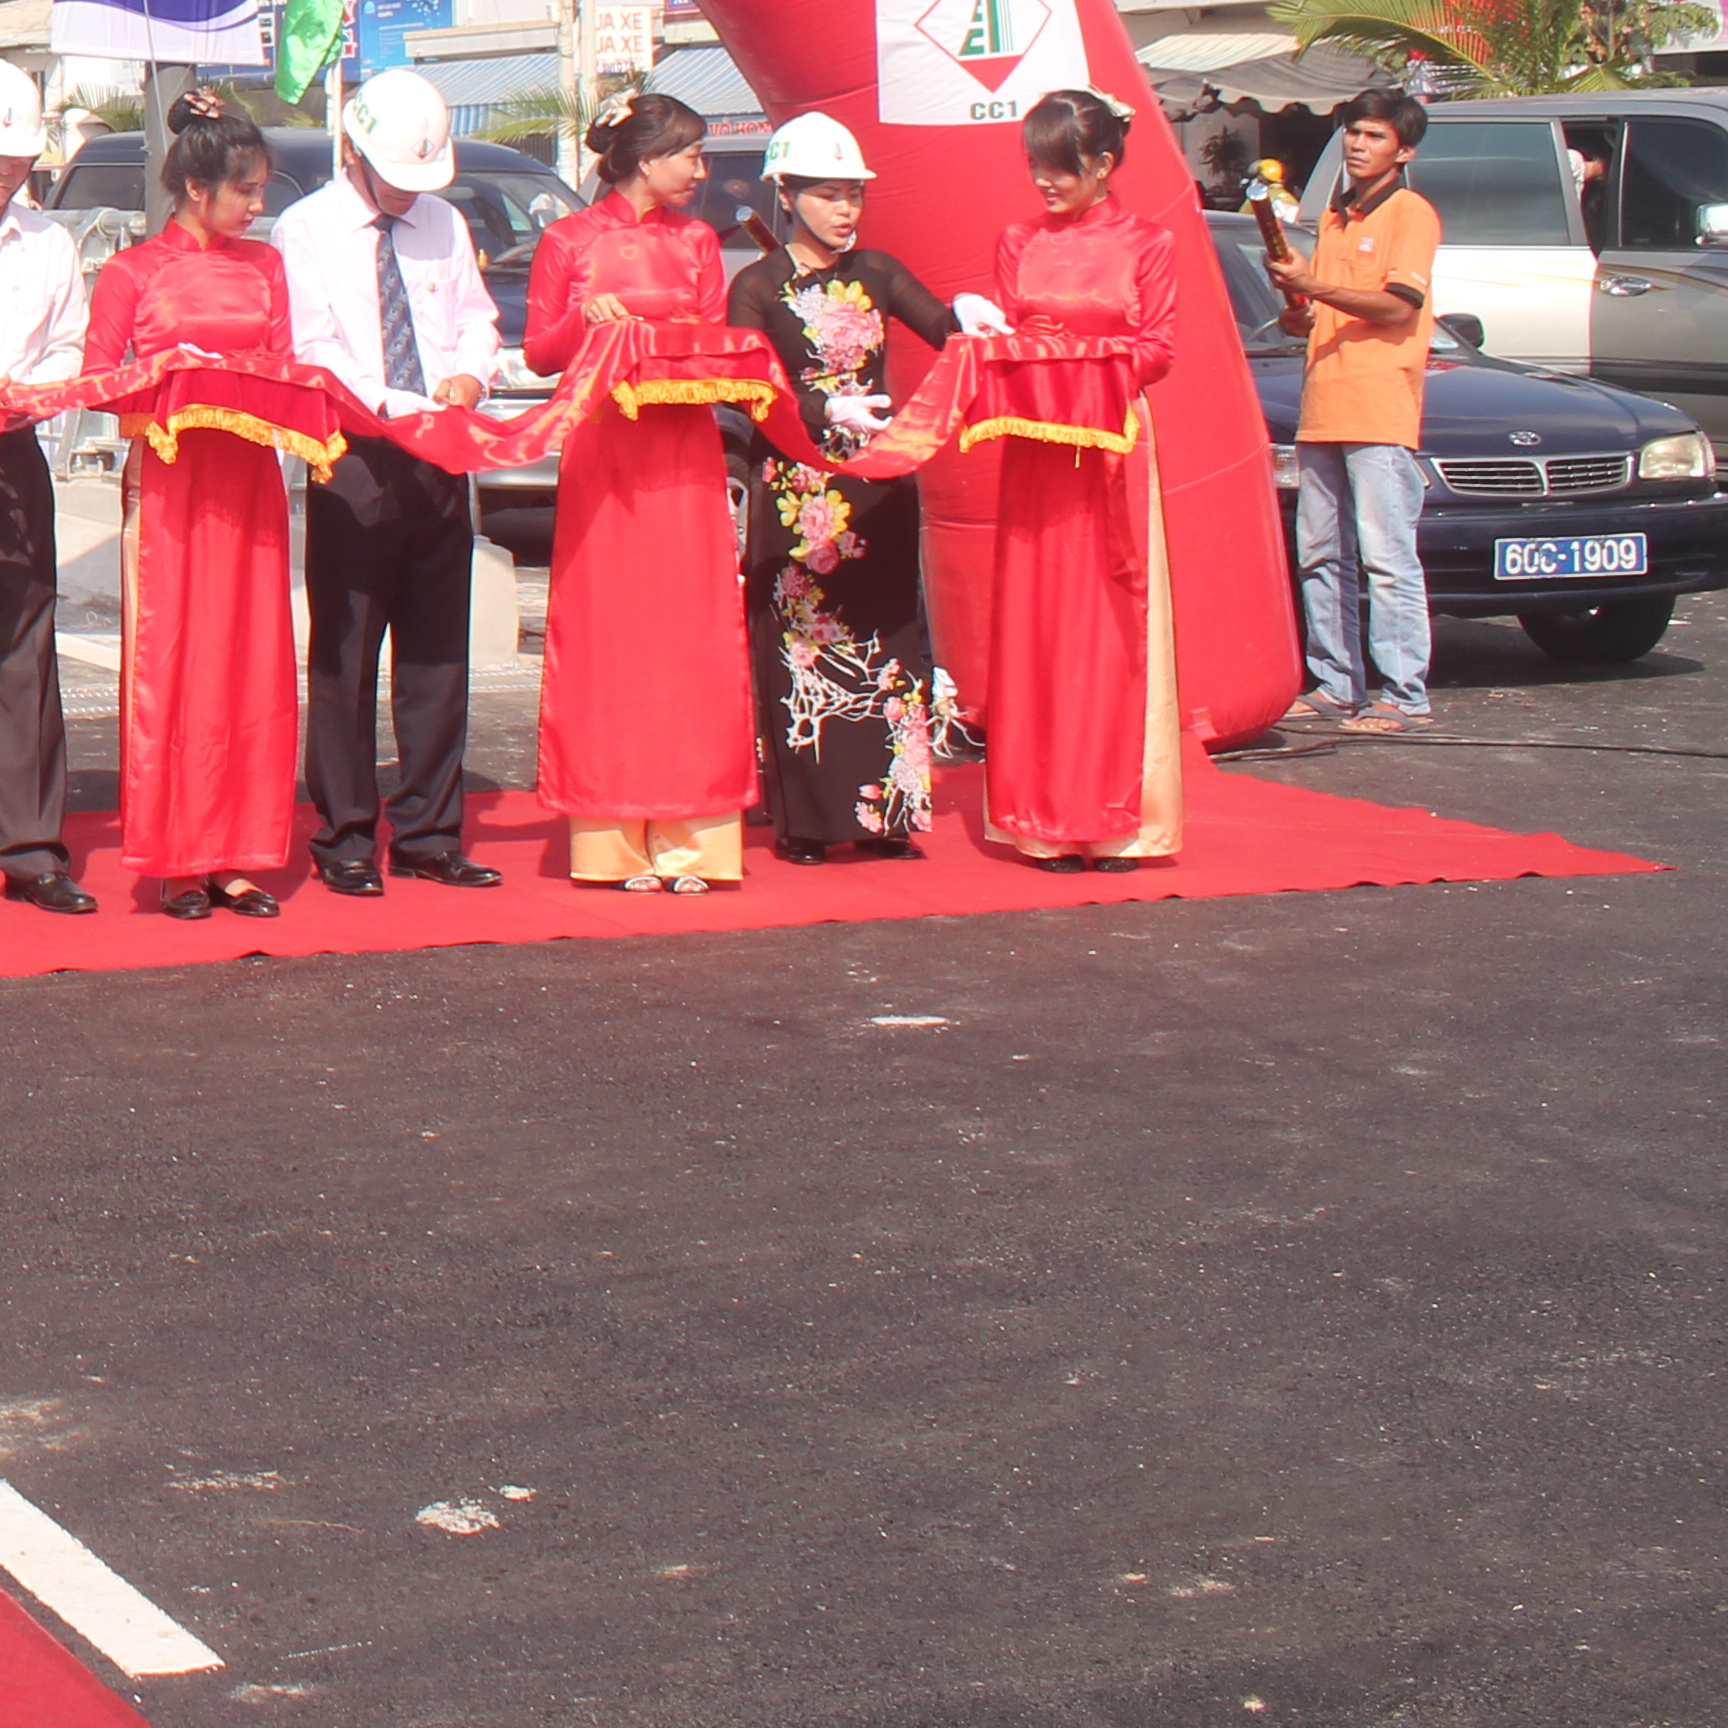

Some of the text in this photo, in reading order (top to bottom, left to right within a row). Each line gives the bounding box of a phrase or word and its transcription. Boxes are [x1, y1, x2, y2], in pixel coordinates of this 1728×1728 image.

[620, 12, 643, 30] XE
[620, 35, 644, 53] XE
[970, 100, 1019, 120] CC1
[1505, 538, 1636, 575] 60C-1909
